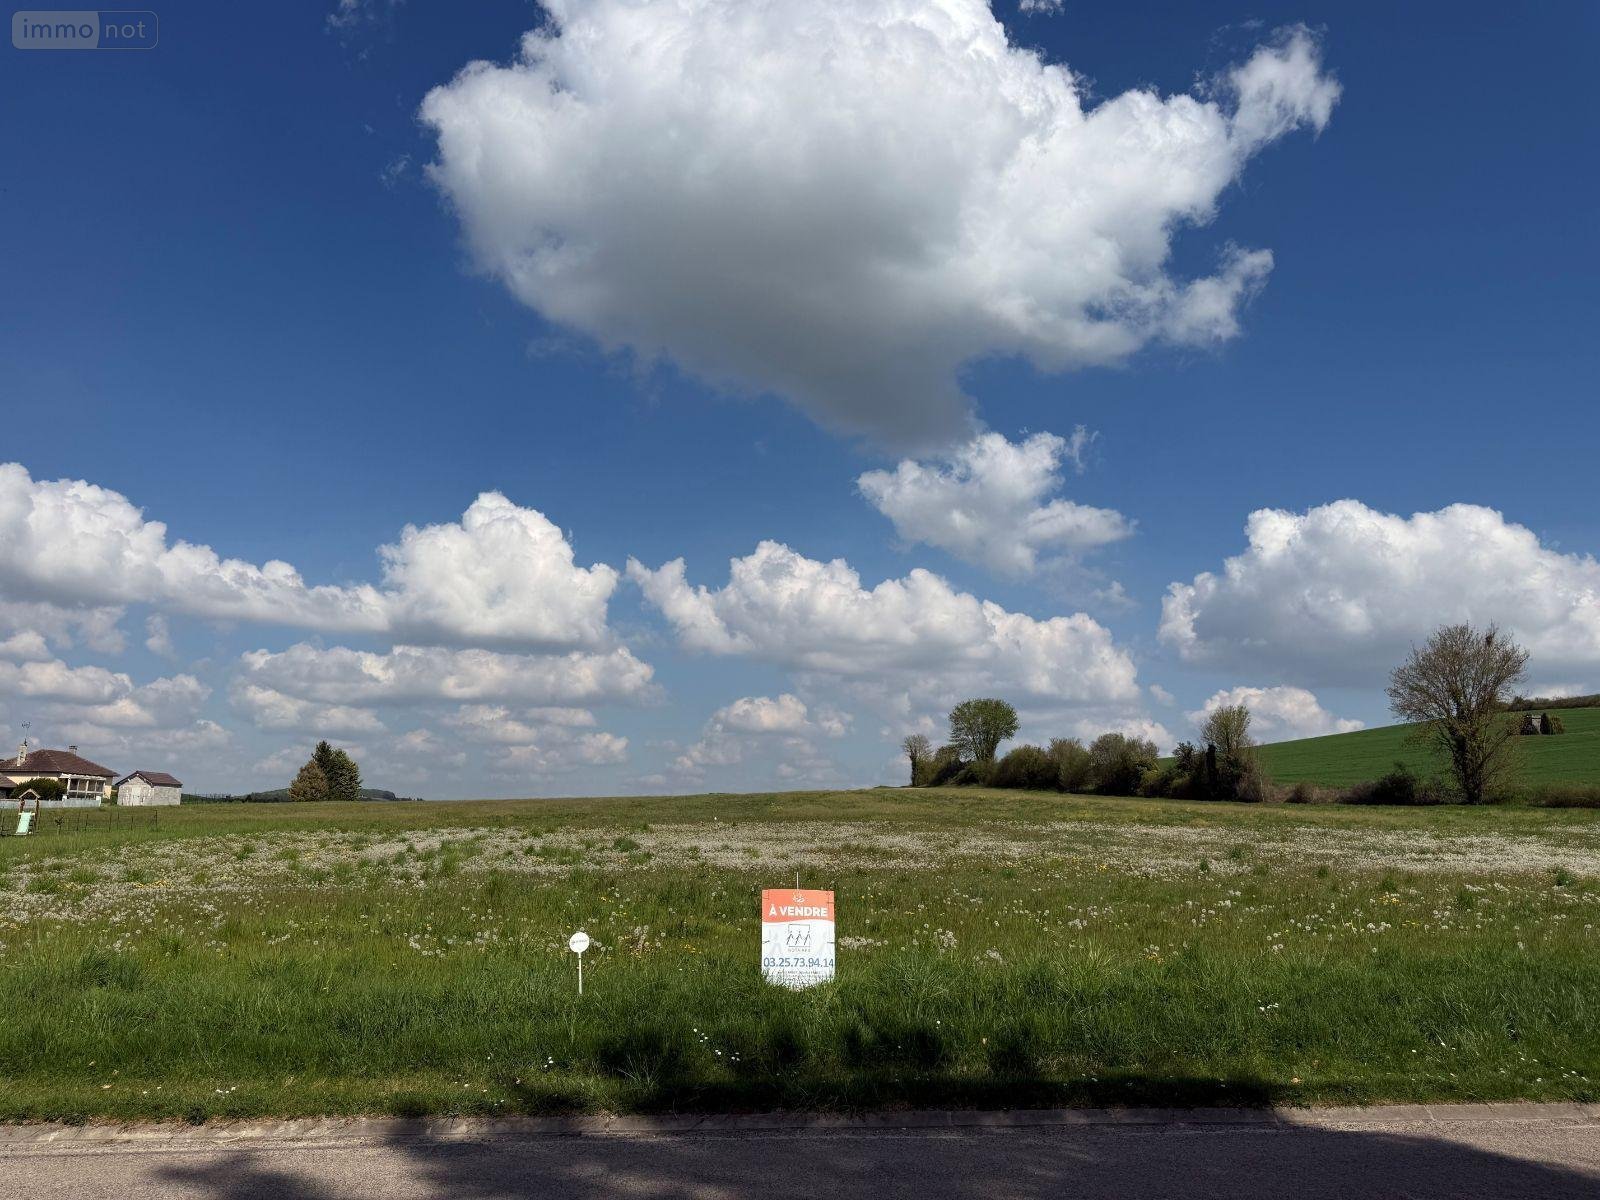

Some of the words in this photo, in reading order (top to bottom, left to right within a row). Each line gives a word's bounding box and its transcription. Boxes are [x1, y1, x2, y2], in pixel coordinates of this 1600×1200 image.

[769, 904, 777, 916] À
[779, 906, 828, 917] VENDRE
[763, 957, 834, 968] 03.25.73.94.14
